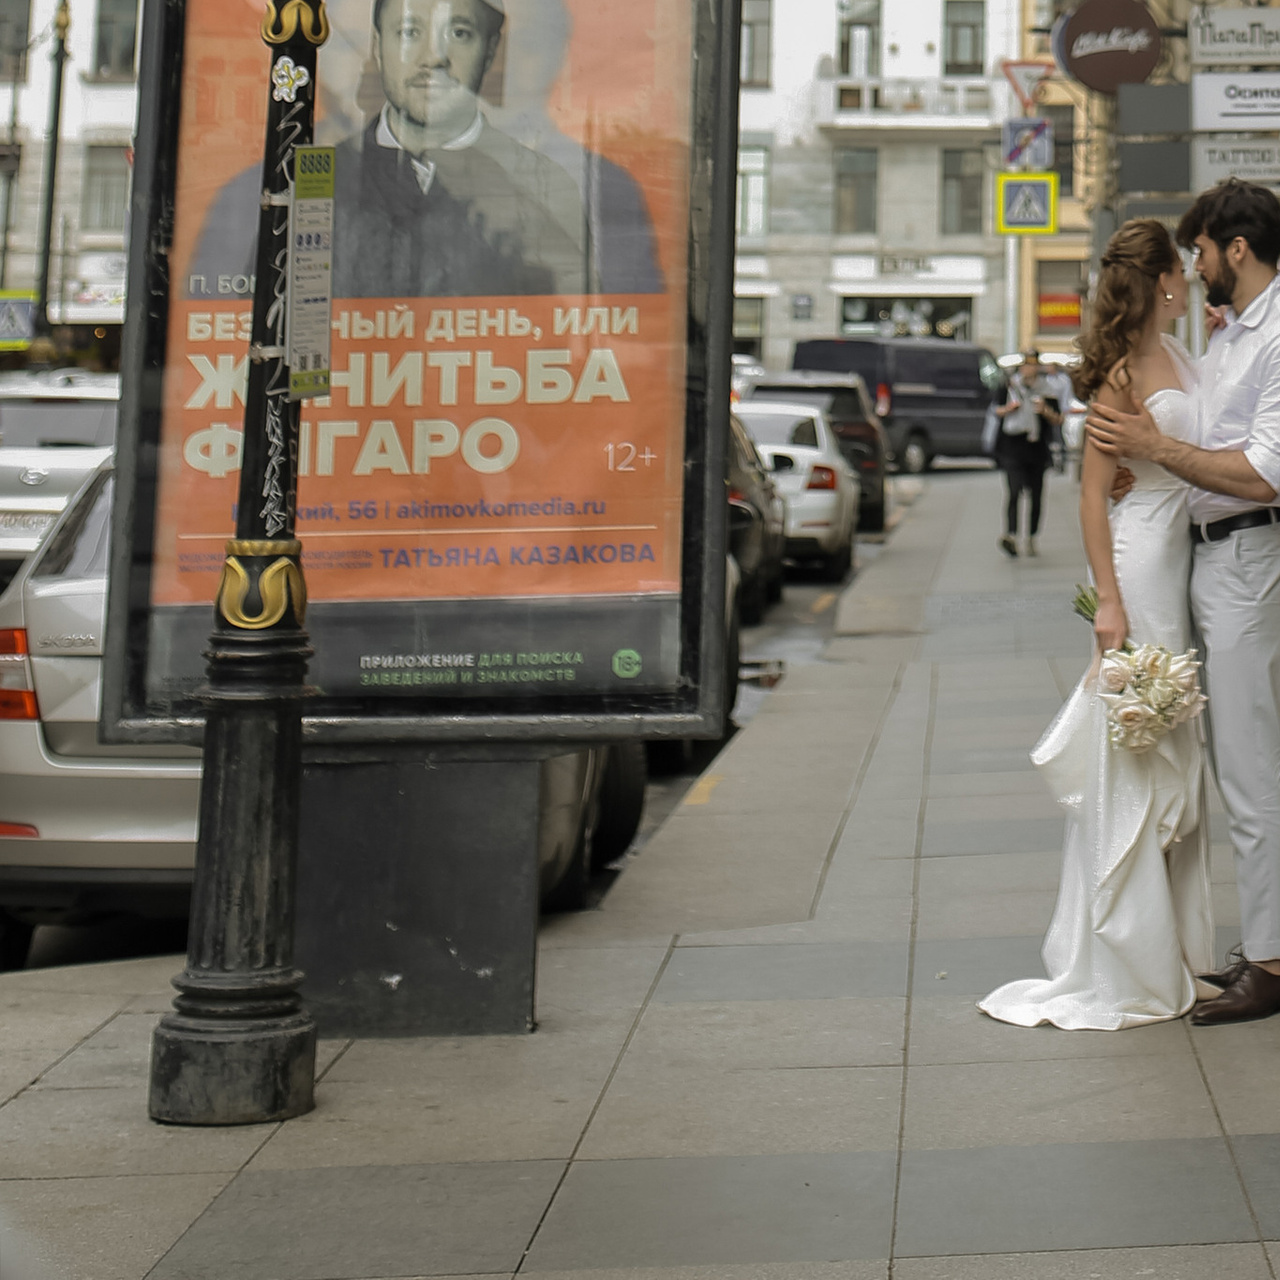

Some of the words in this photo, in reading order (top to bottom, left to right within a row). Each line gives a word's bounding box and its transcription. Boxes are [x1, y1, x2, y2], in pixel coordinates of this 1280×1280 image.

[187, 305, 415, 341] БЕЗНЫЙ
[426, 308, 543, 342] ДЕНЬ,
[554, 306, 639, 336] ИЛИ
[184, 349, 631, 410] ЖНИТЬБА
[603, 442, 658, 472] 12+
[348, 500, 378, 521] 56
[396, 498, 606, 520] akimovkomedia.ru
[379, 545, 501, 569] ТАТЬЯНА
[510, 543, 656, 566] КАЗАКОВА
[360, 653, 476, 669] ПРИЛОЖЕНИЕ
[477, 652, 513, 668] ДЛЯ
[516, 651, 585, 666] ПОИСКА
[360, 670, 458, 687] ЗАВЕДЕНИЙ
[460, 671, 473, 683] И
[476, 668, 577, 683] ЗНАКОМСТВ
